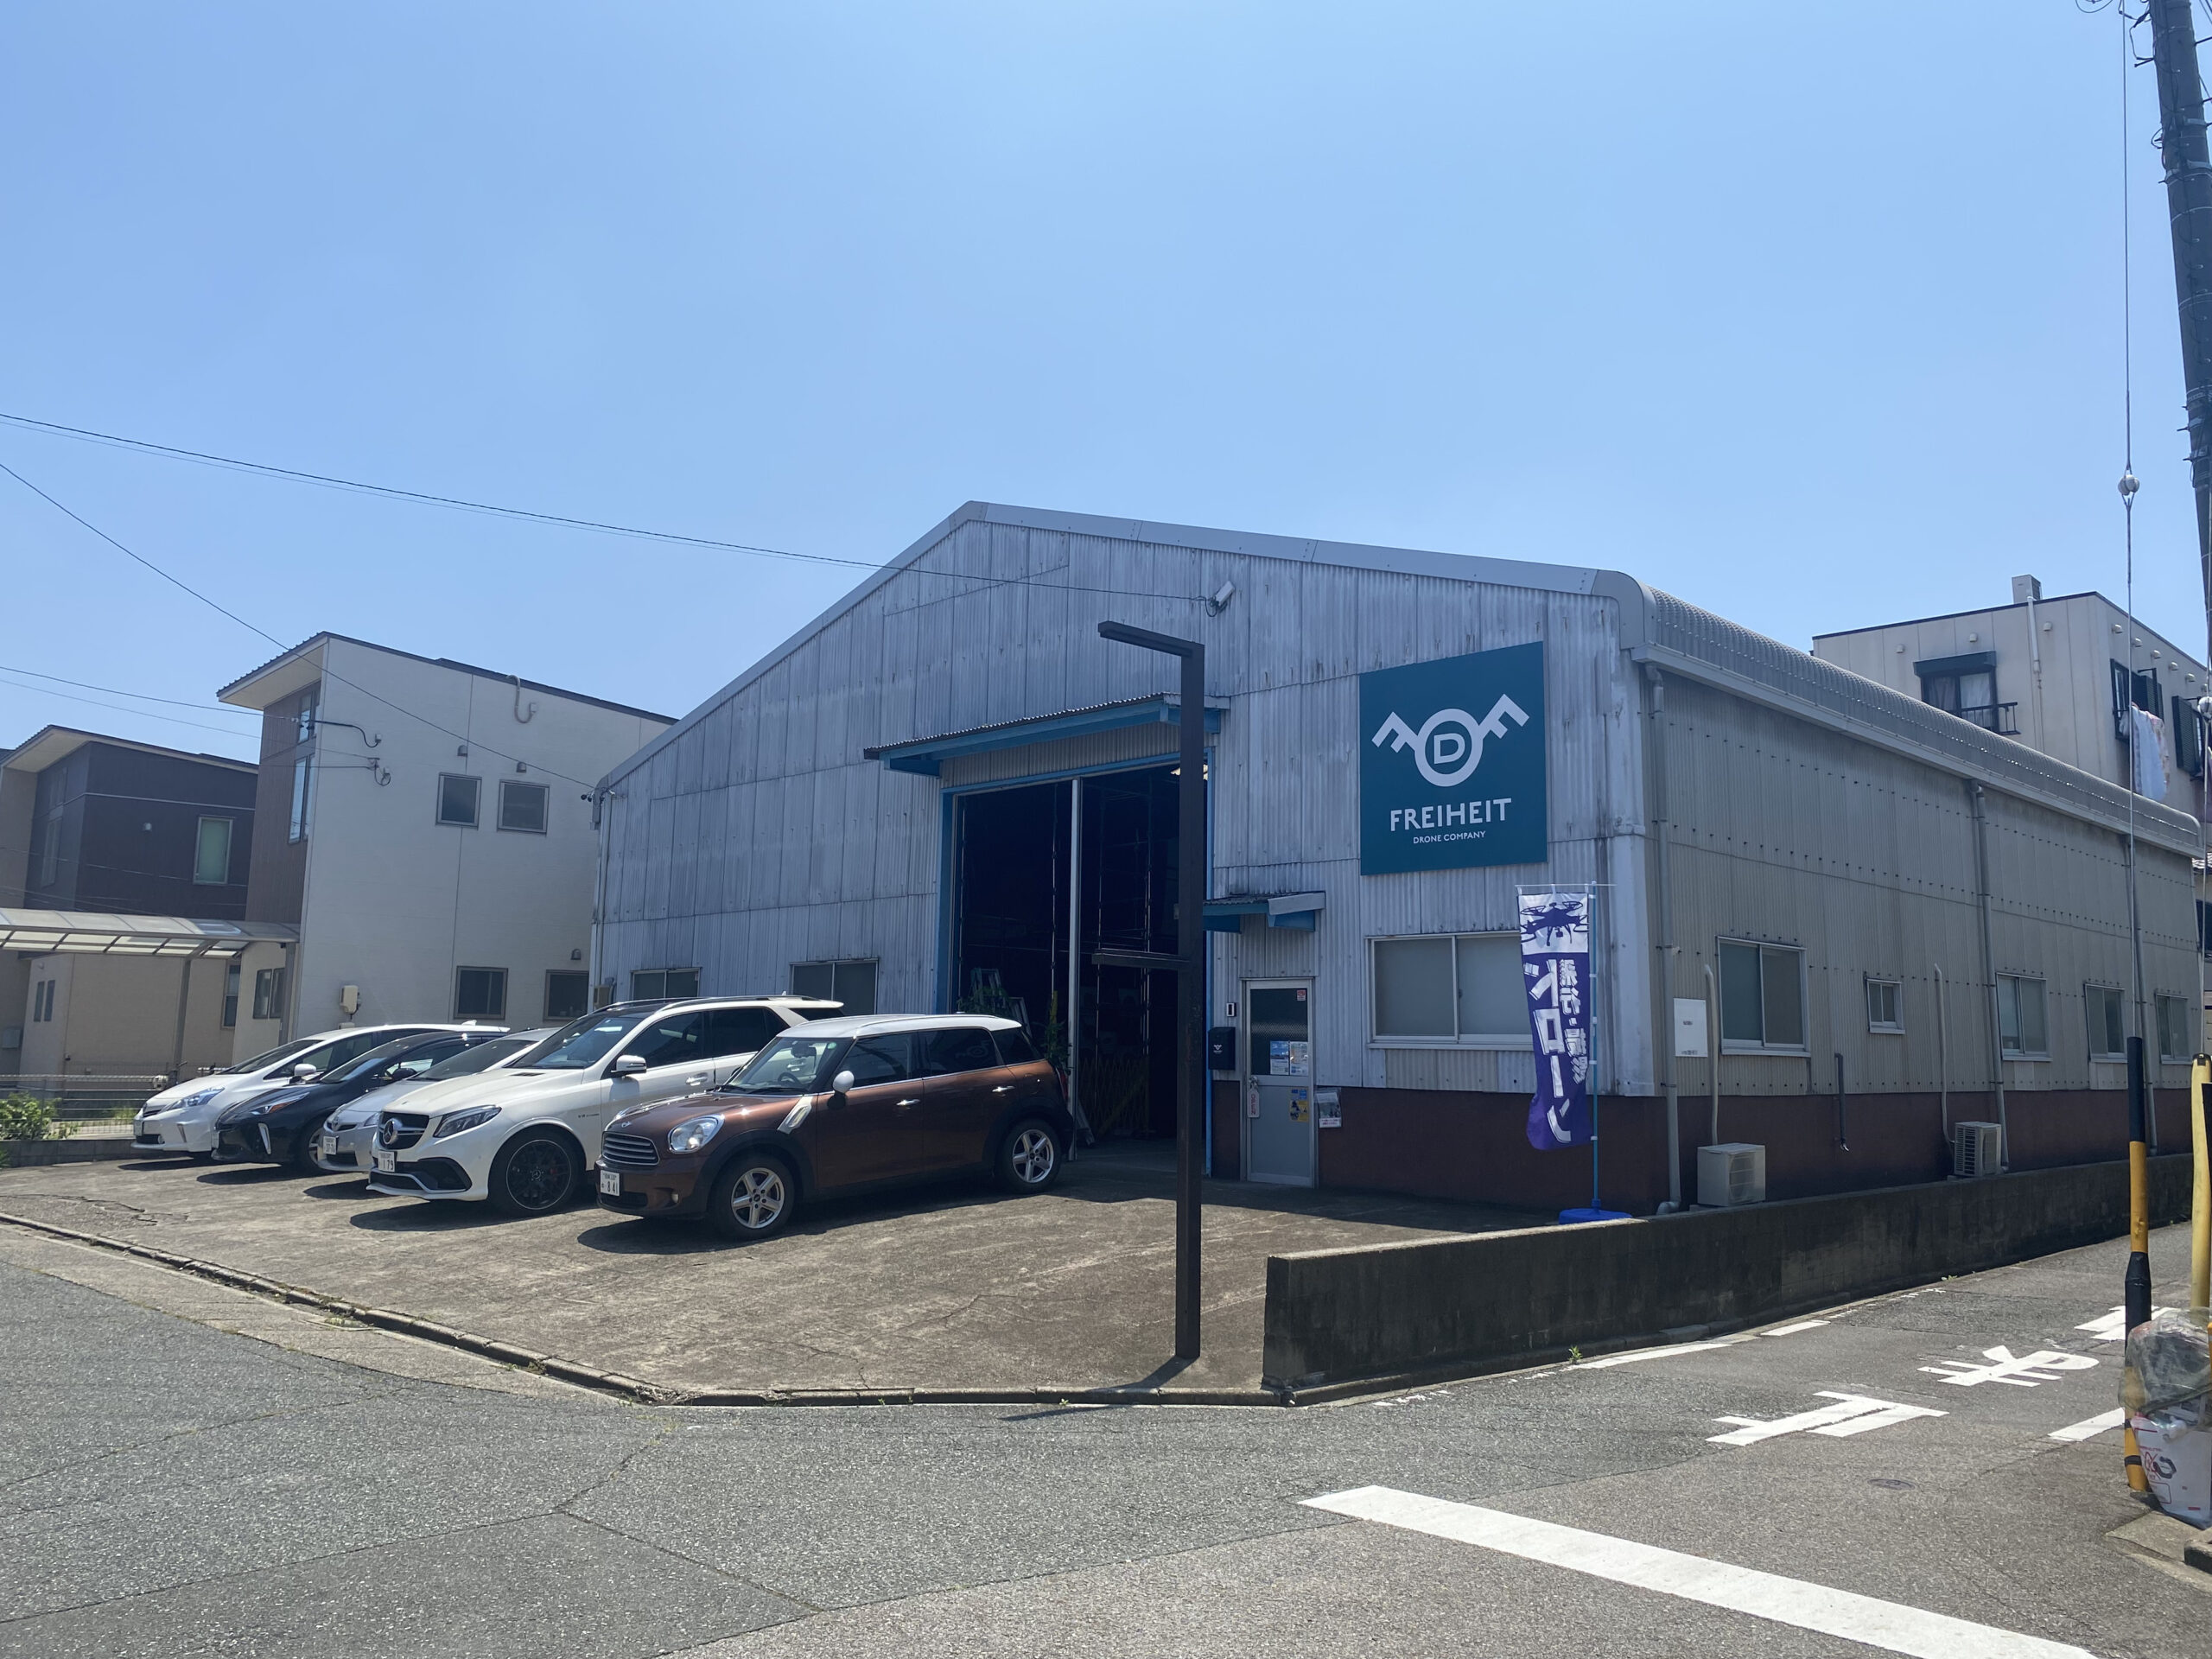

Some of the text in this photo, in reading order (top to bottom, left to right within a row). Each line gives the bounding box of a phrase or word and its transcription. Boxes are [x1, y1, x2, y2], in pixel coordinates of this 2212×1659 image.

[1389, 798, 1512, 832] FREIHEIT
[1413, 830, 1486, 844] DRONE COMPANY
